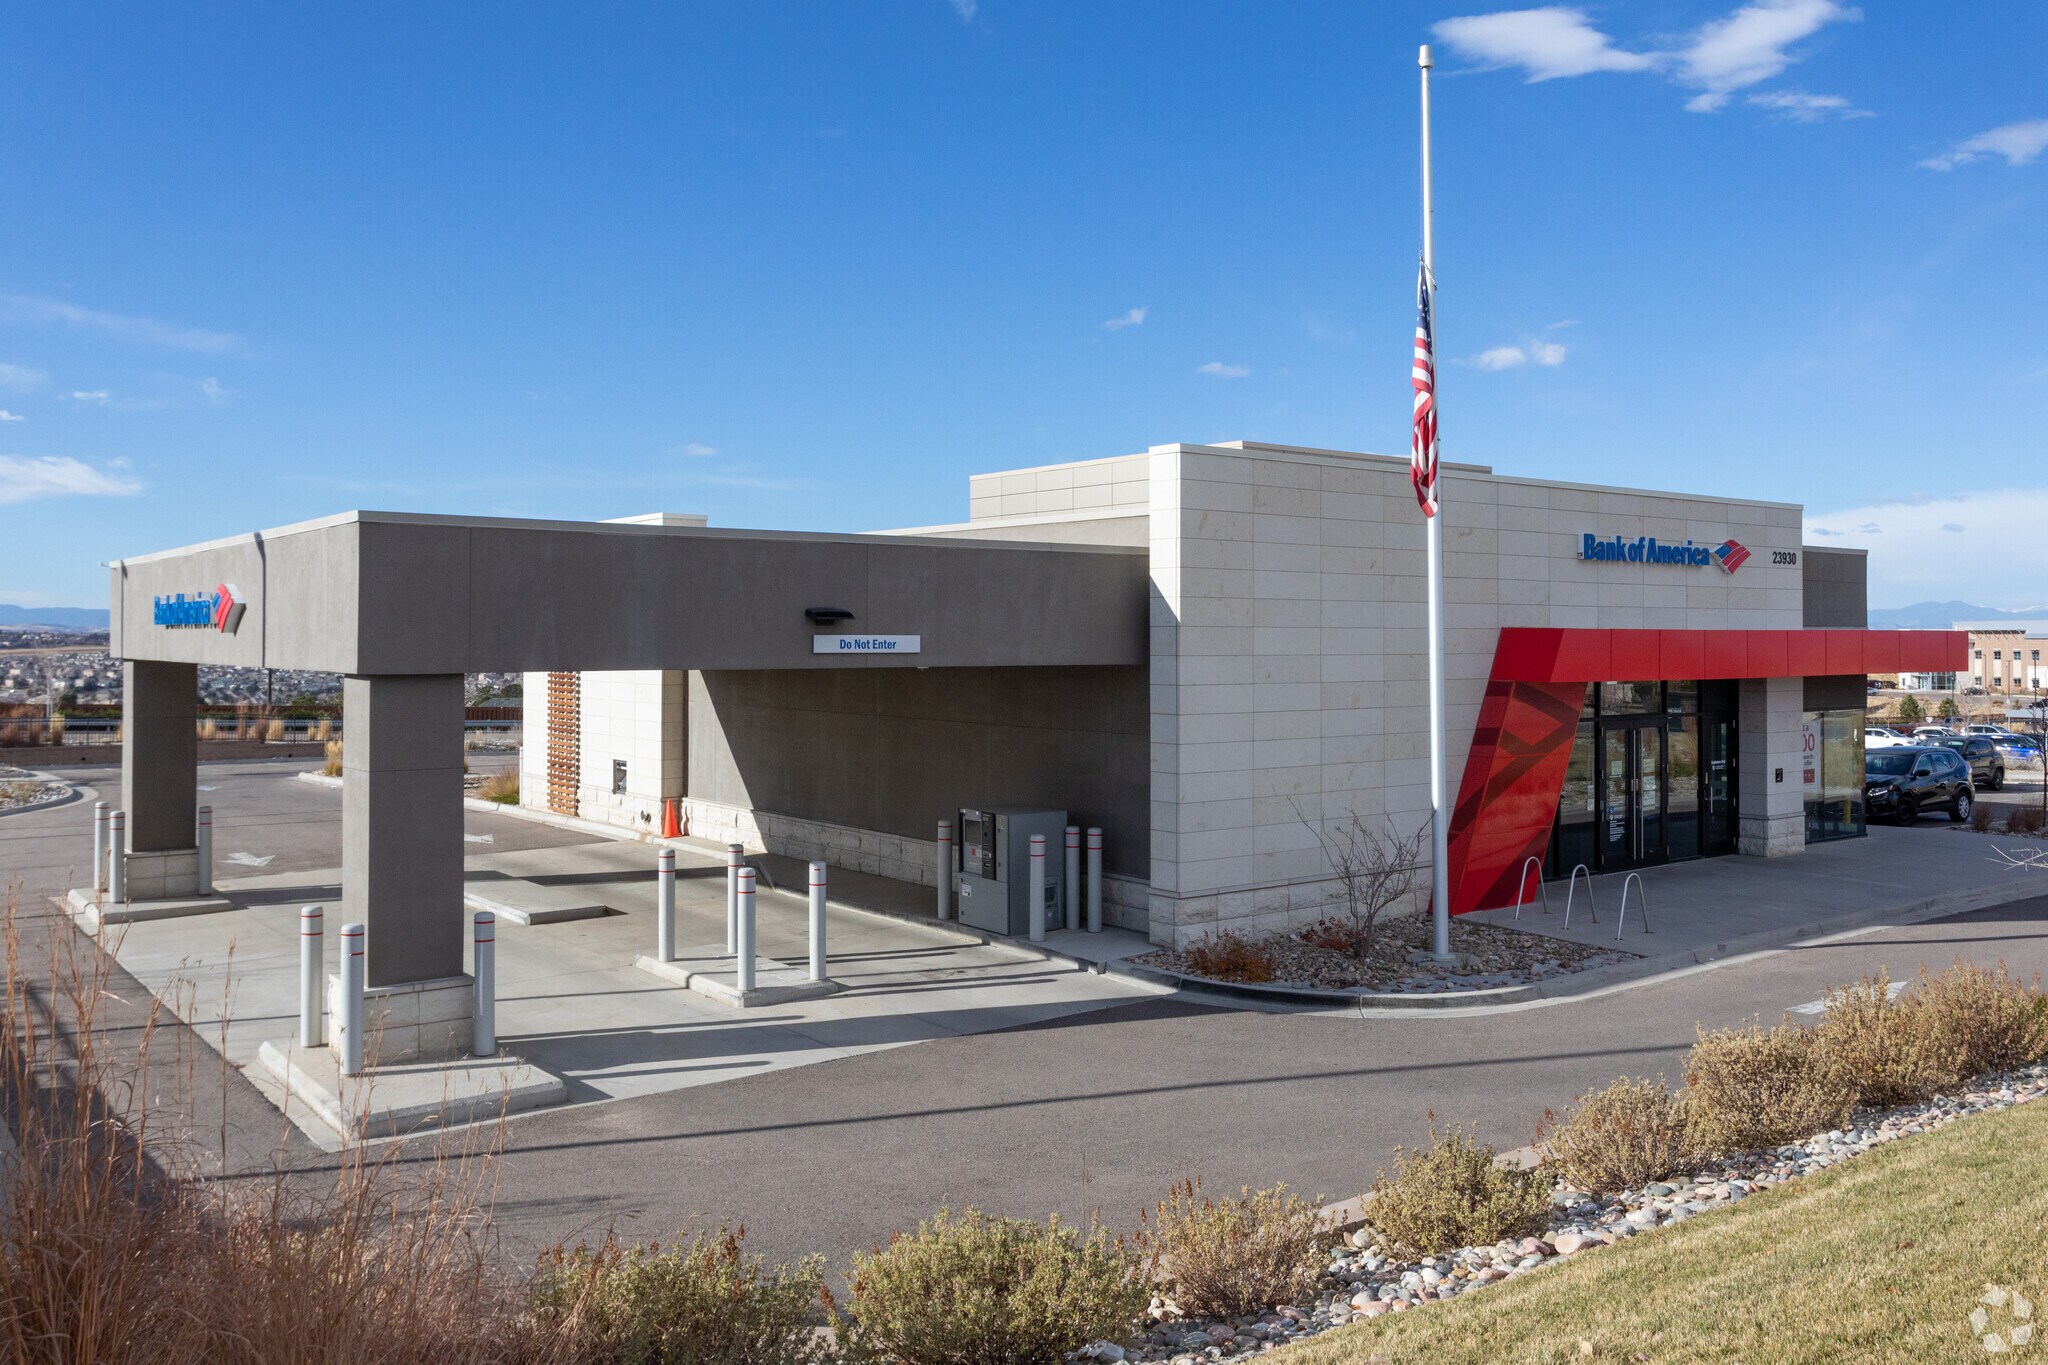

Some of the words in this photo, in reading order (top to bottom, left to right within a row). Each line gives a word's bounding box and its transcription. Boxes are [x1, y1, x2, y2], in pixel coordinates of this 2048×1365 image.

[1583, 533, 1628, 561] Bank
[1628, 536, 1646, 562] of
[1646, 537, 1710, 566] America
[1772, 551, 1797, 565] 23930
[840, 639, 852, 649] Do
[854, 639, 870, 649] Not
[872, 639, 897, 649] Enter
